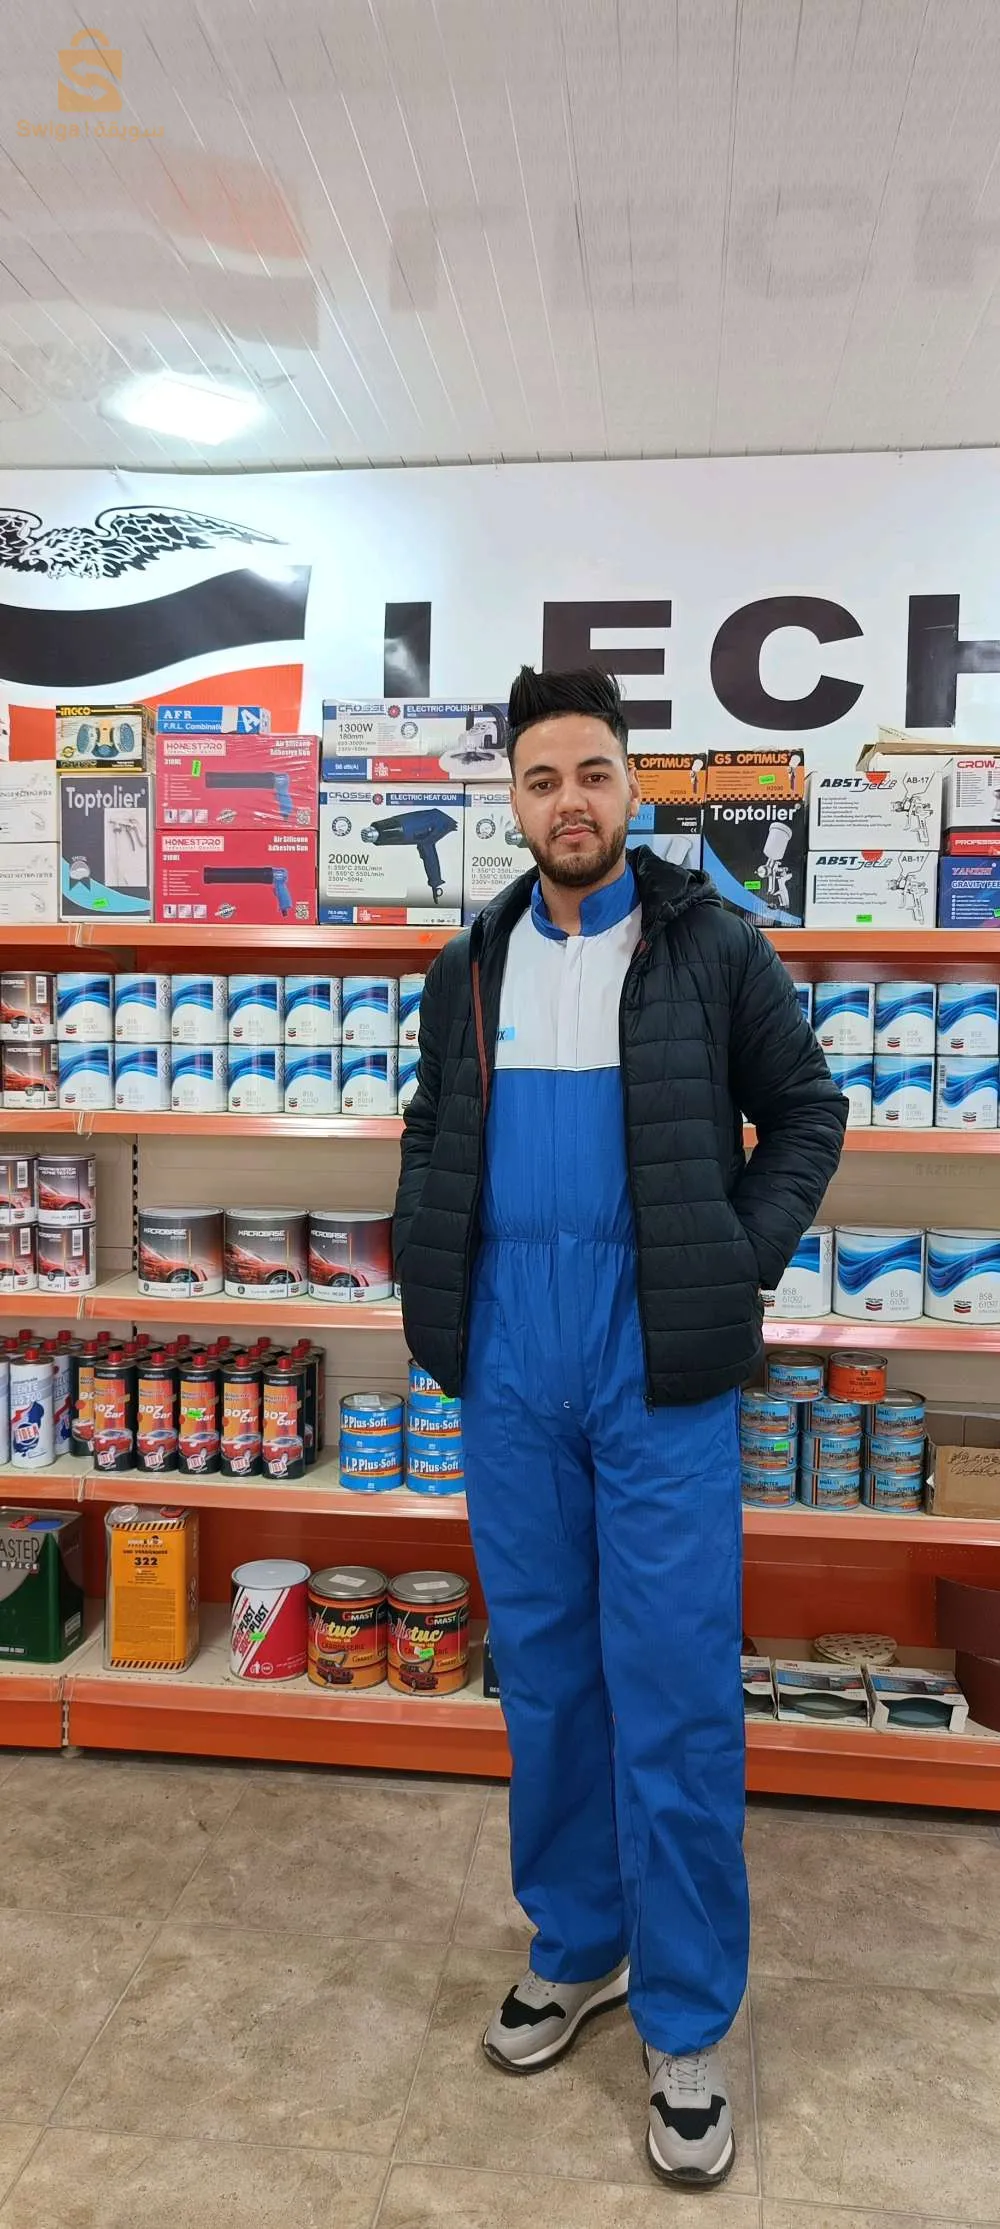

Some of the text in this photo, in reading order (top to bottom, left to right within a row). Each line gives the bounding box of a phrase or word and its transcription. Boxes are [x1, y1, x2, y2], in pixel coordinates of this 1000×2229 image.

[164, 709, 192, 719] AFR
[407, 705, 444, 713] ELECTRIC
[339, 723, 373, 732] 1300W
[640, 758, 691, 769] OPTIMUS
[715, 753, 788, 764] GS OPTIMUS
[820, 778, 862, 787] ABST
[66, 785, 141, 816] Toptolier
[710, 804, 796, 824] Toptolier
[165, 838, 220, 846] HONESTPRO
[328, 853, 370, 864] 2000W
[472, 857, 512, 867] 2000W
[815, 856, 858, 865] ABST
[951, 880, 986, 889] GRAVITY
[104, 1411, 124, 1419] Car
[152, 1411, 172, 1419] Car
[224, 1408, 258, 1423] 907 Car
[277, 1418, 296, 1426] Car
[349, 1416, 387, 1429] Plus-Soft
[421, 1418, 459, 1431] Plus-Soft
[359, 1457, 397, 1471] Plus-Soft
[420, 1459, 459, 1472] Plus-Soft
[134, 1557, 158, 1566] 322
[425, 1615, 457, 1626] GMAST
